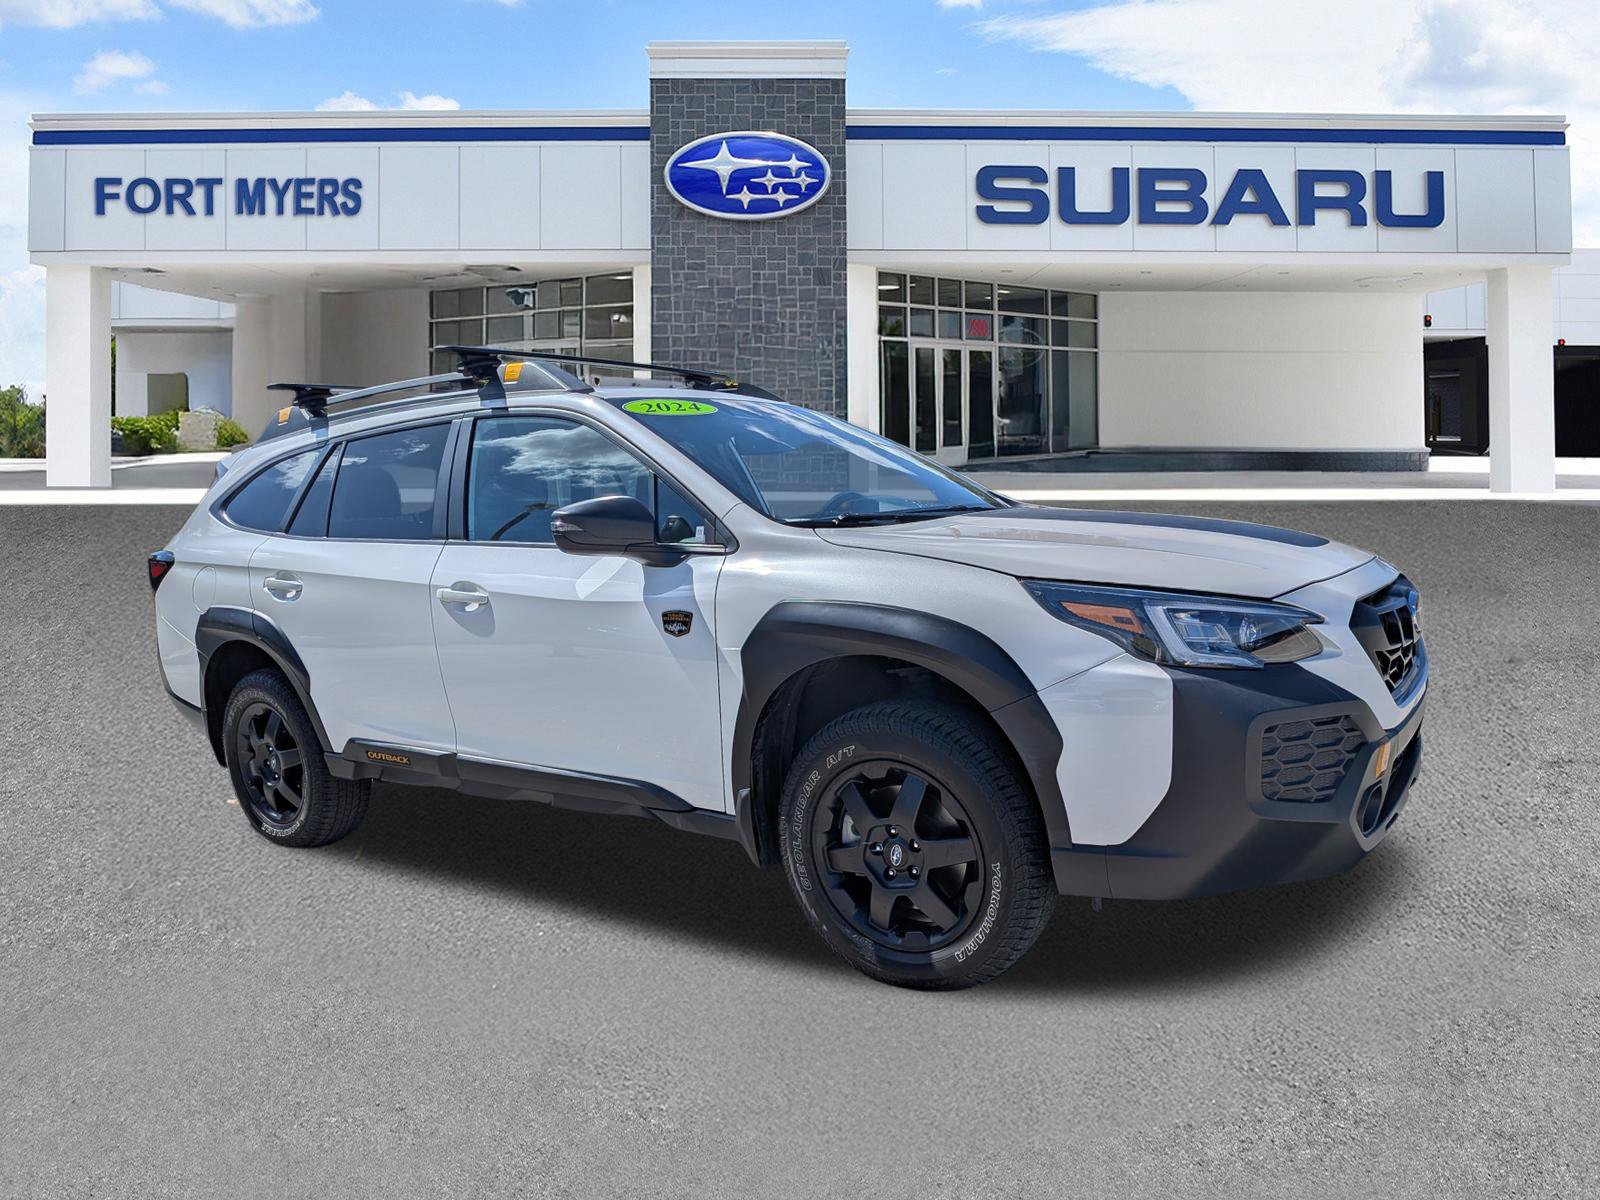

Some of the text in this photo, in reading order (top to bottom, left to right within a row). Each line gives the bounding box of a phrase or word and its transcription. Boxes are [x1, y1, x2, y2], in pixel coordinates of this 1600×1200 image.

[94, 177, 363, 217] FORT MYERS
[976, 164, 1445, 228] SUBARU
[640, 402, 701, 413] 2024
[367, 751, 410, 765] OUTBACK
[826, 745, 855, 768] A/T
[955, 862, 1001, 963] YOKOHAMA
